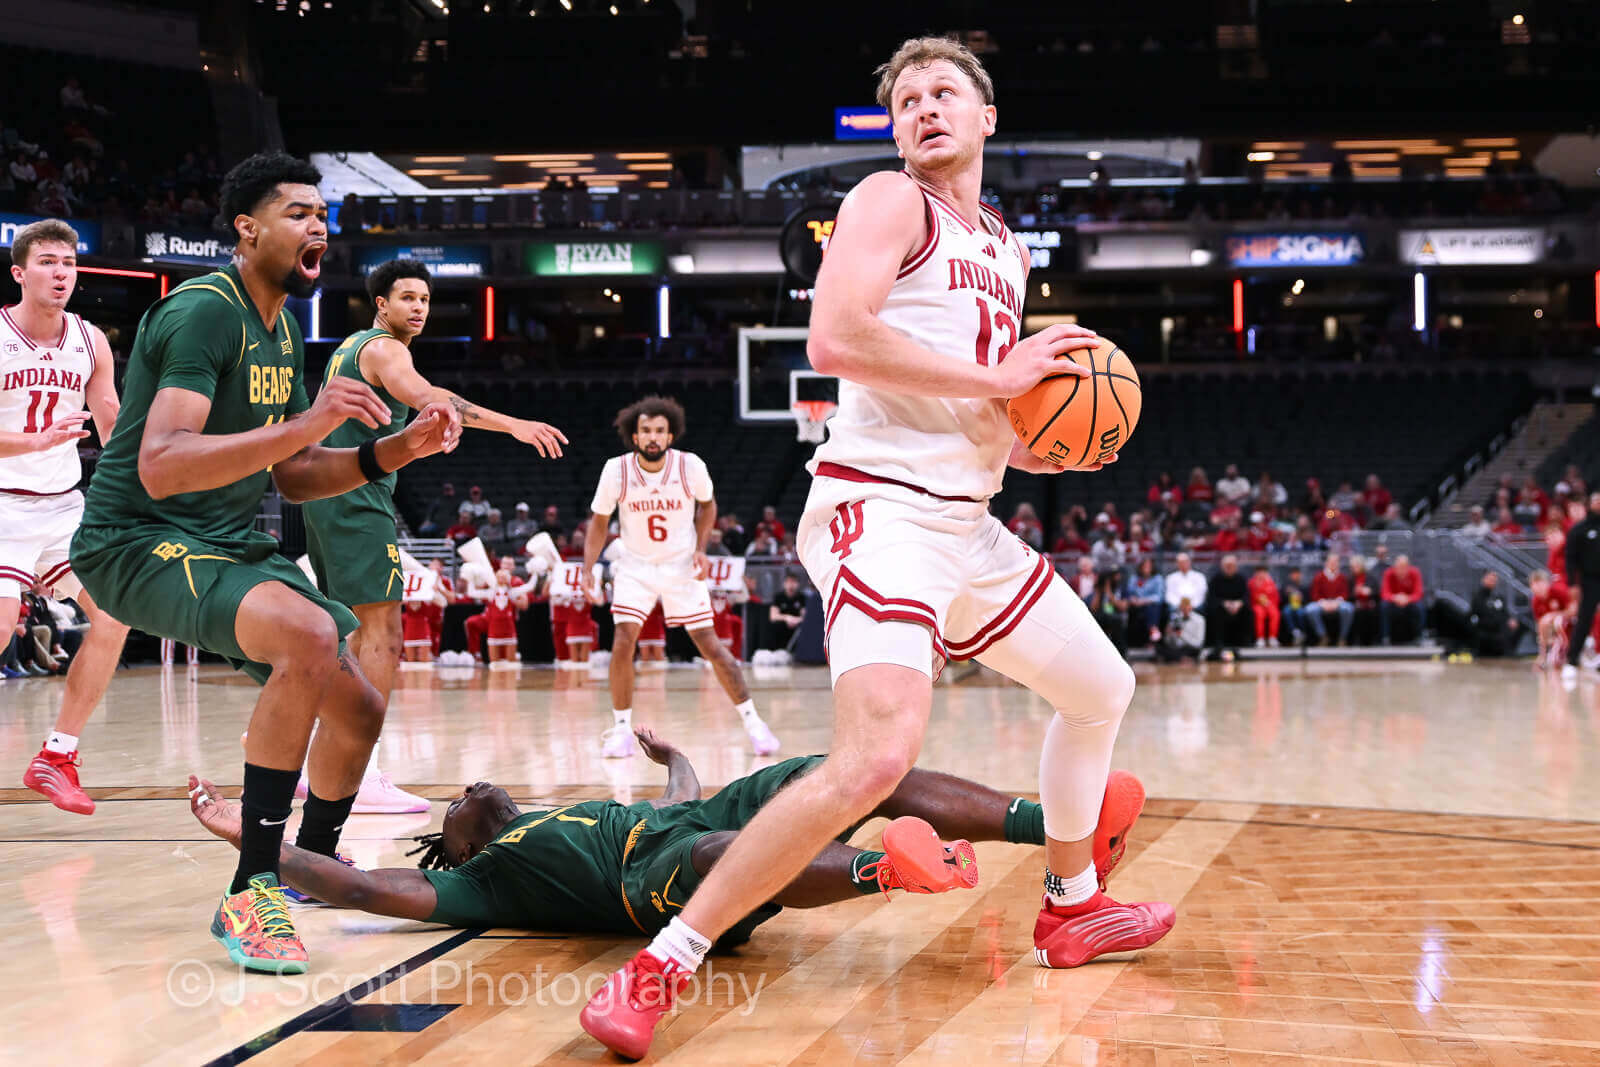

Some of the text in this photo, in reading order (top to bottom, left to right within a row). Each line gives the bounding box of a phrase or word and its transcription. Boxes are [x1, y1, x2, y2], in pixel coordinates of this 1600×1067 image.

[169, 236, 218, 257] Ruoff
[570, 243, 632, 262] RYAN
[3, 367, 81, 392] INDIANA
[249, 364, 294, 405] BEARS
[23, 390, 59, 433] 11
[628, 500, 682, 512] INDIANA
[647, 514, 667, 542] 6
